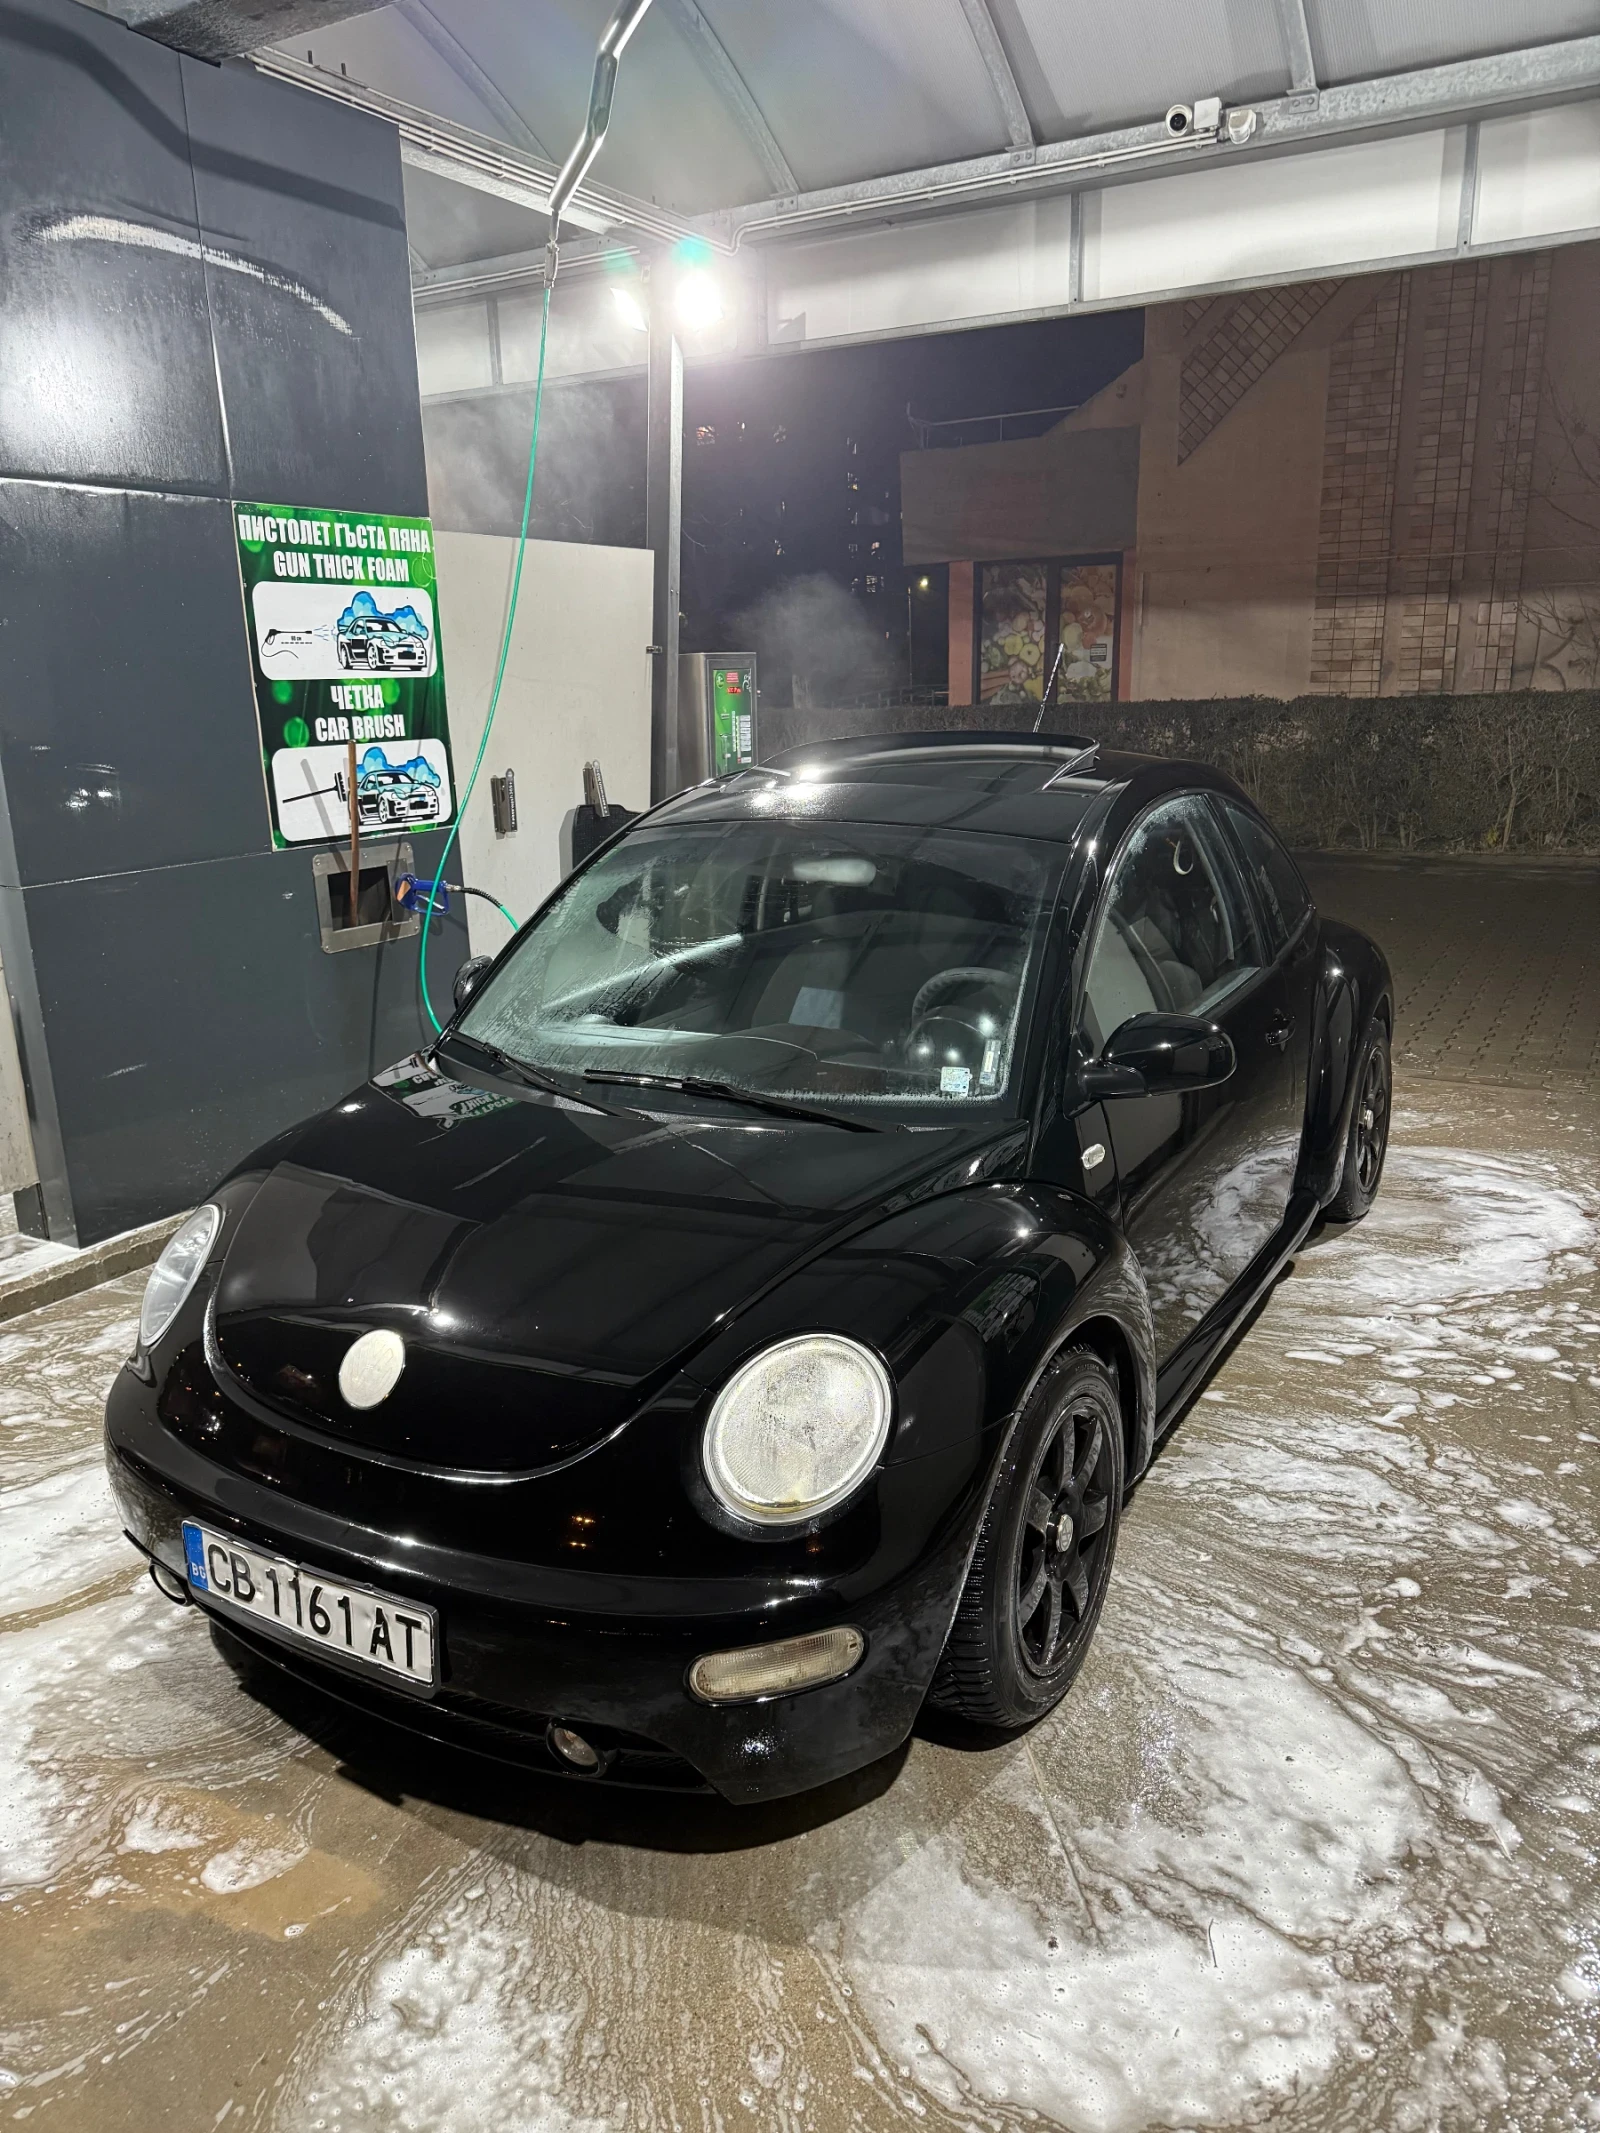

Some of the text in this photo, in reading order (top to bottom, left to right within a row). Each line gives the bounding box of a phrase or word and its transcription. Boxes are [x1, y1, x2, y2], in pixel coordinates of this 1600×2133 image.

[238, 514, 431, 553] ПИСТОЛЕТ ГЪСТА ПЯНА
[273, 550, 410, 583] GUN THICK FOAM
[330, 684, 385, 711] ЧЕТКА
[315, 714, 405, 742] CAR BRUSH
[191, 1562, 206, 1580] BG
[265, 1565, 353, 1647] 1161
